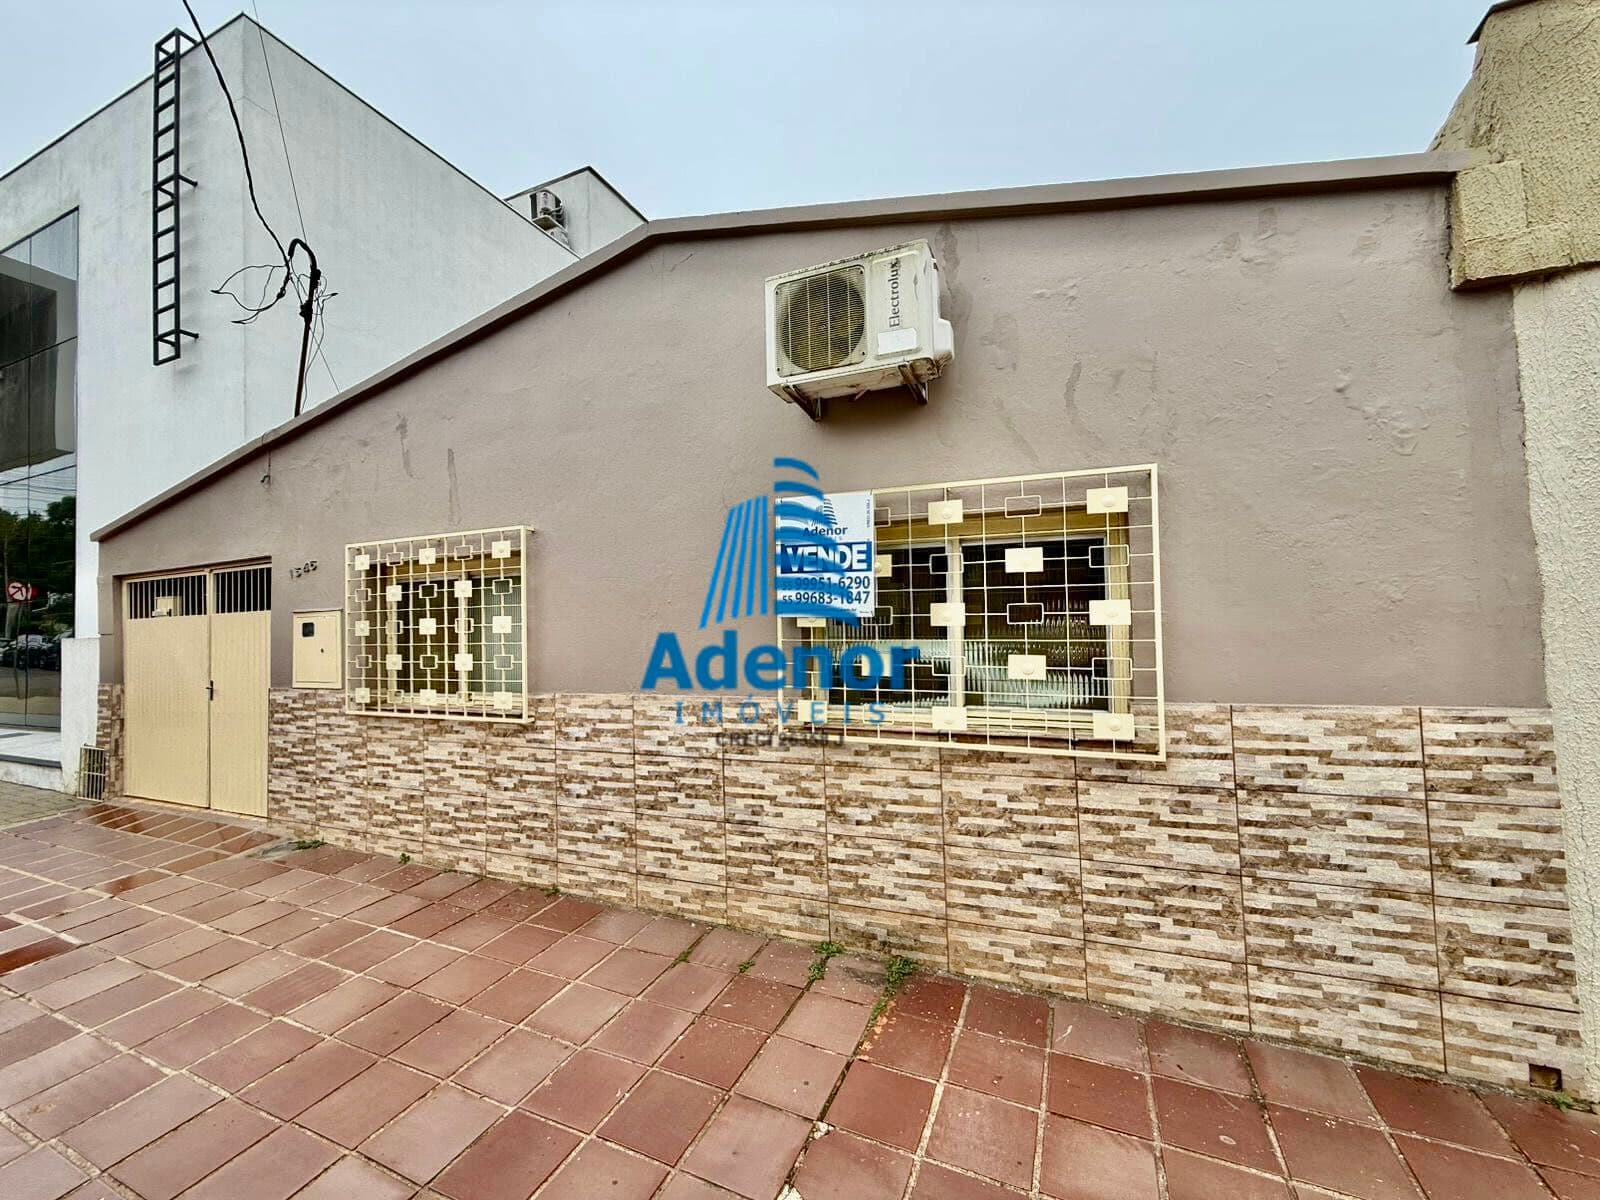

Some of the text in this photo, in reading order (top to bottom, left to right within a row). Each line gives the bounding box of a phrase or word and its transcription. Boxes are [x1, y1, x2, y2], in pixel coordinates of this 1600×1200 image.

[888, 257, 900, 328] Electrolux
[802, 526, 848, 536] Adenor
[786, 544, 868, 572] VENDE
[290, 560, 318, 579] 1545
[795, 576, 870, 590] 99951-6290
[795, 591, 870, 604] 99683-1847
